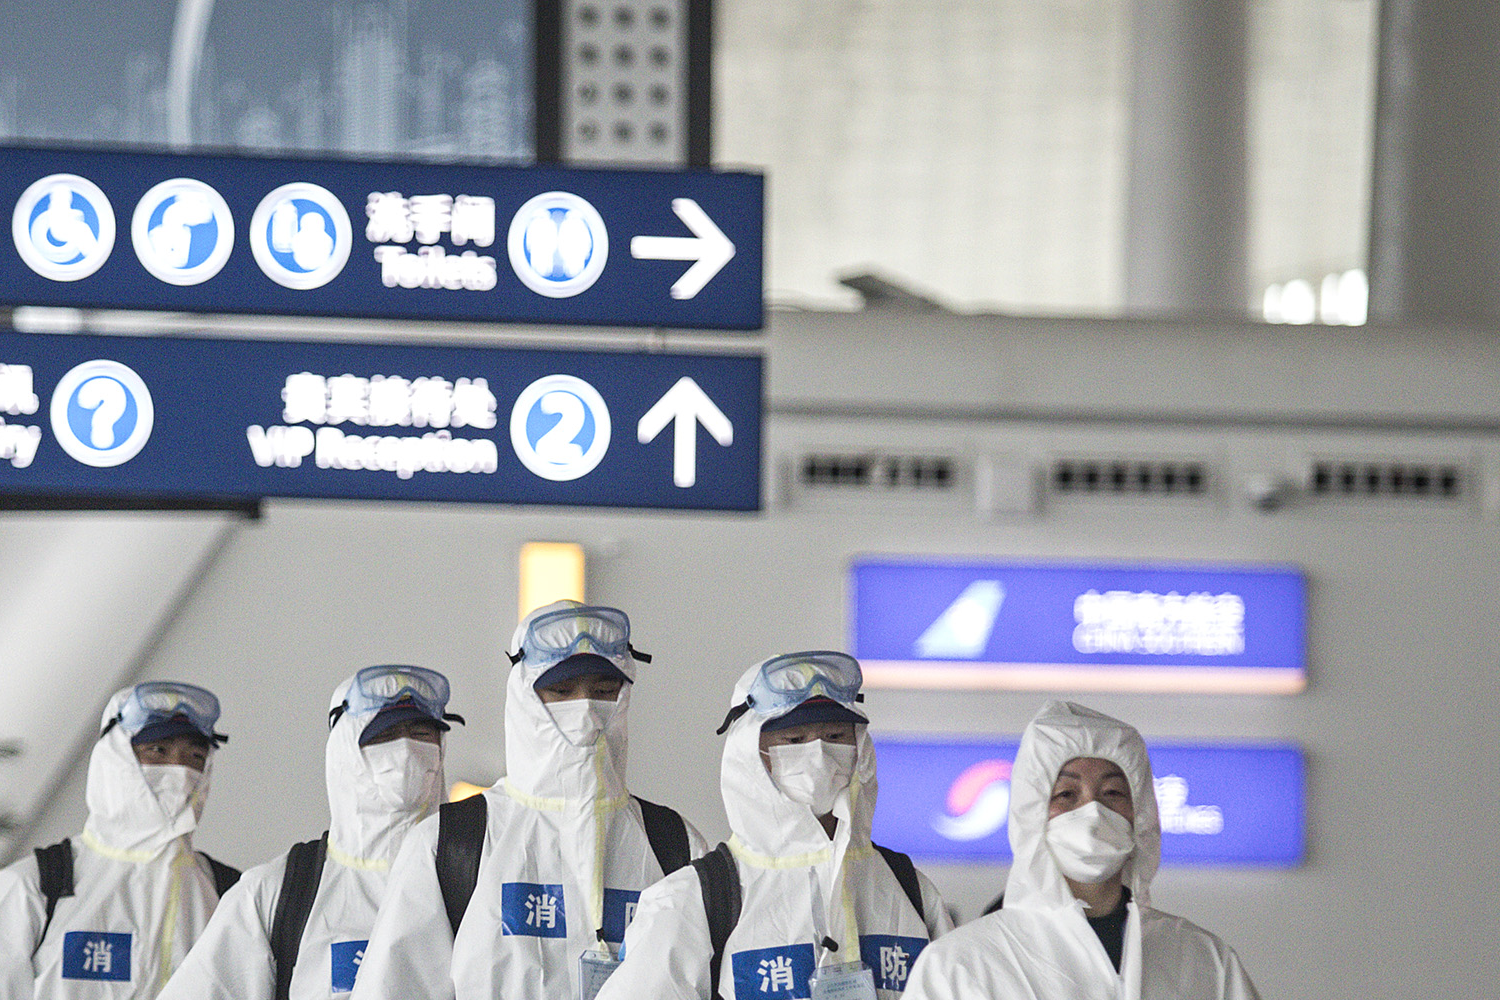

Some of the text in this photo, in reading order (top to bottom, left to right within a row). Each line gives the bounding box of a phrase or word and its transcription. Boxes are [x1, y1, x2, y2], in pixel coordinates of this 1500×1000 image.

[373, 245, 497, 291] Toilets
[540, 389, 584, 464] 2
[247, 424, 498, 480] VIP Reception
[525, 893, 557, 929] 消
[82, 940, 112, 973] 消
[757, 944, 910, 992] 消 防
